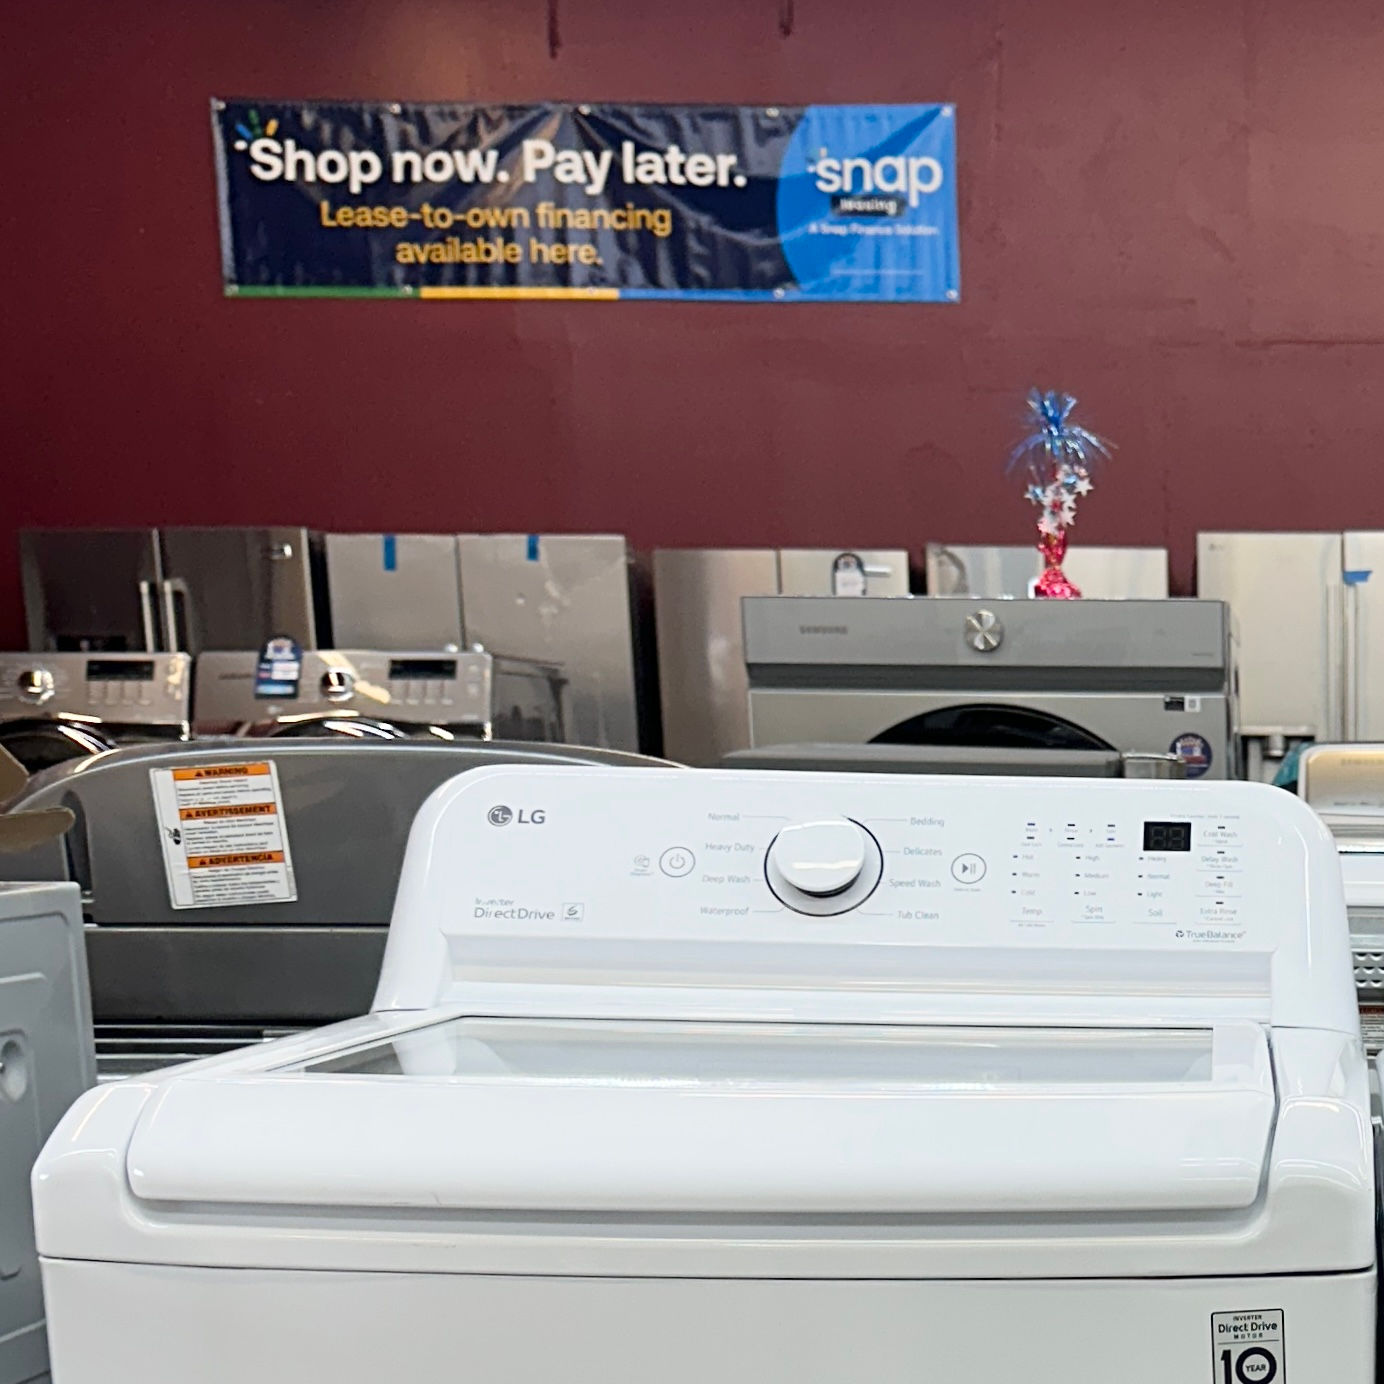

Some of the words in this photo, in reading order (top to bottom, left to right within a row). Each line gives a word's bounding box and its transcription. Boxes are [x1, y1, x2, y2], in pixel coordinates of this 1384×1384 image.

[249, 138, 383, 194] Shop
[391, 149, 510, 183] now.
[522, 138, 613, 195] Pay
[622, 140, 748, 187] later.
[816, 155, 943, 208] snap
[319, 200, 530, 229] Lease-to-own
[535, 201, 673, 238] financing
[395, 236, 524, 264] available
[529, 237, 604, 265] here.
[204, 766, 248, 777] WARNING
[518, 809, 546, 824] LG
[910, 817, 945, 827] Bedding
[705, 843, 732, 853] Heavy
[734, 843, 755, 853] Duty
[903, 848, 943, 856] Delicates
[727, 875, 750, 883] Wash
[889, 879, 915, 889] Speed
[918, 880, 941, 888] Wash
[898, 911, 913, 920] Tub
[915, 911, 939, 920] Clean
[1218, 1322, 1249, 1333] Direct
[1251, 1321, 1278, 1331] Drive
[1234, 1332, 1263, 1340] MOTOR
[1245, 1364, 1267, 1373] YEAR
